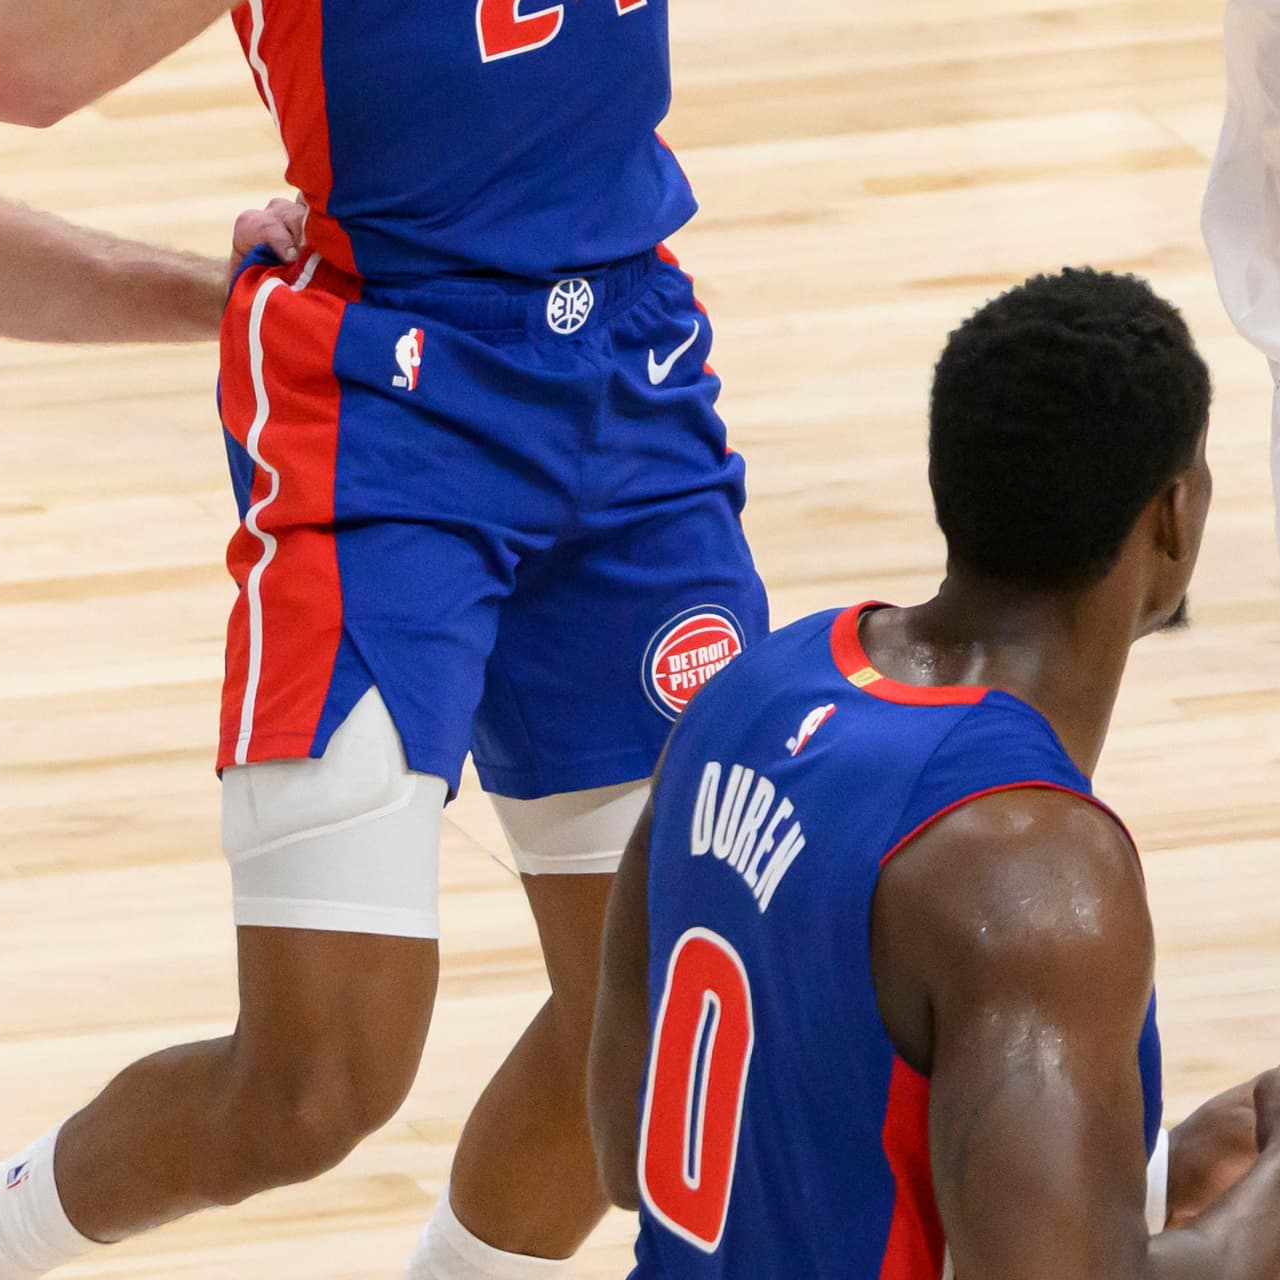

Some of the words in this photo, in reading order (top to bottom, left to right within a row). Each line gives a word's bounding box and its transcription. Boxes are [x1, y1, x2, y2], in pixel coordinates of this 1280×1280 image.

[668, 638, 730, 673] DETROIT
[691, 761, 806, 914] DUREN
[637, 926, 756, 1255] 0
